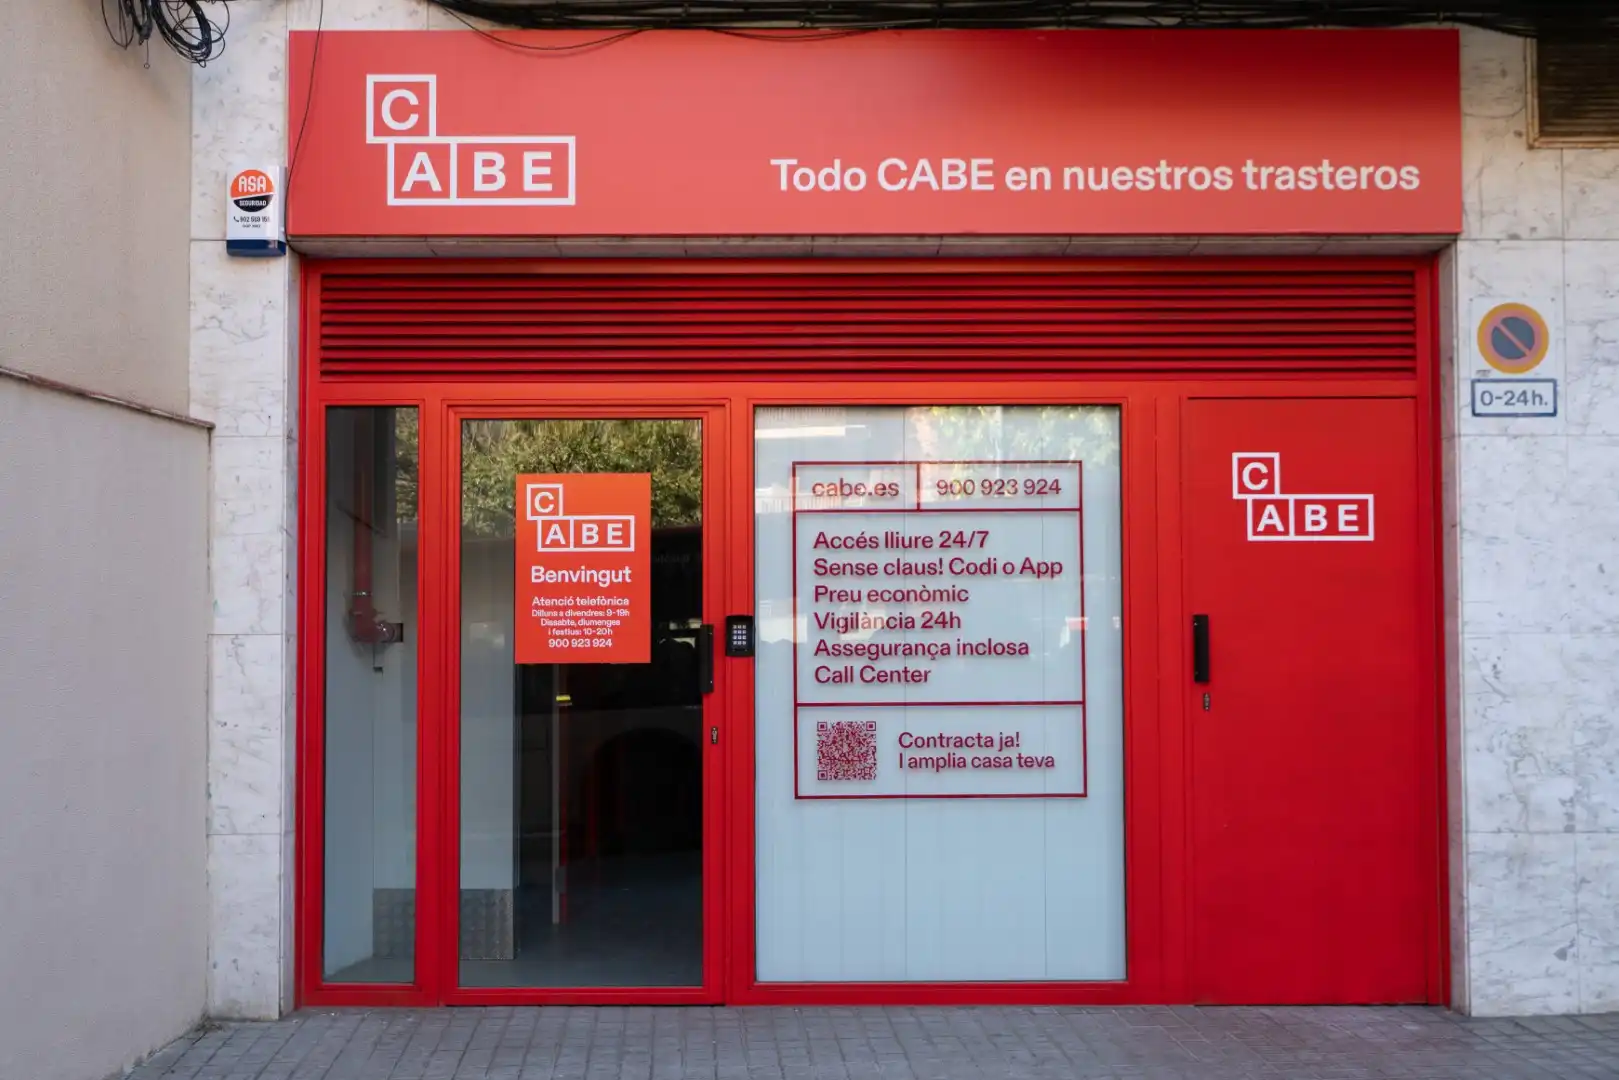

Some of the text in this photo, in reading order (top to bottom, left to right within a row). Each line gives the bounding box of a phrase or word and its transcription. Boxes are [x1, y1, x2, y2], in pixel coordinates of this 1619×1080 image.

[238, 175, 267, 192] ASA
[770, 157, 1421, 192] Todo CABE en nuestros trasteros
[812, 478, 899, 497] cabe.es
[936, 478, 1062, 496] 900 923 924
[813, 531, 990, 549] Accés lliure 24/7
[531, 565, 632, 587] Benvingut
[813, 557, 1063, 579] Sense claus! Codi o App
[532, 596, 630, 606] Atenció telefònica
[813, 585, 969, 603] Preu econòmic
[540, 618, 620, 627] Dissabte, diumenges
[813, 611, 961, 634] Vigilància 24h
[552, 628, 581, 636] festius:
[548, 638, 612, 648] 900 923 924
[813, 639, 1030, 660] Assegurança inclosa
[814, 666, 932, 684] Call Center
[898, 731, 1021, 752] Contracta ja!
[907, 752, 967, 772] amplia
[971, 755, 1012, 768] casa
[1016, 753, 1055, 768] teva
